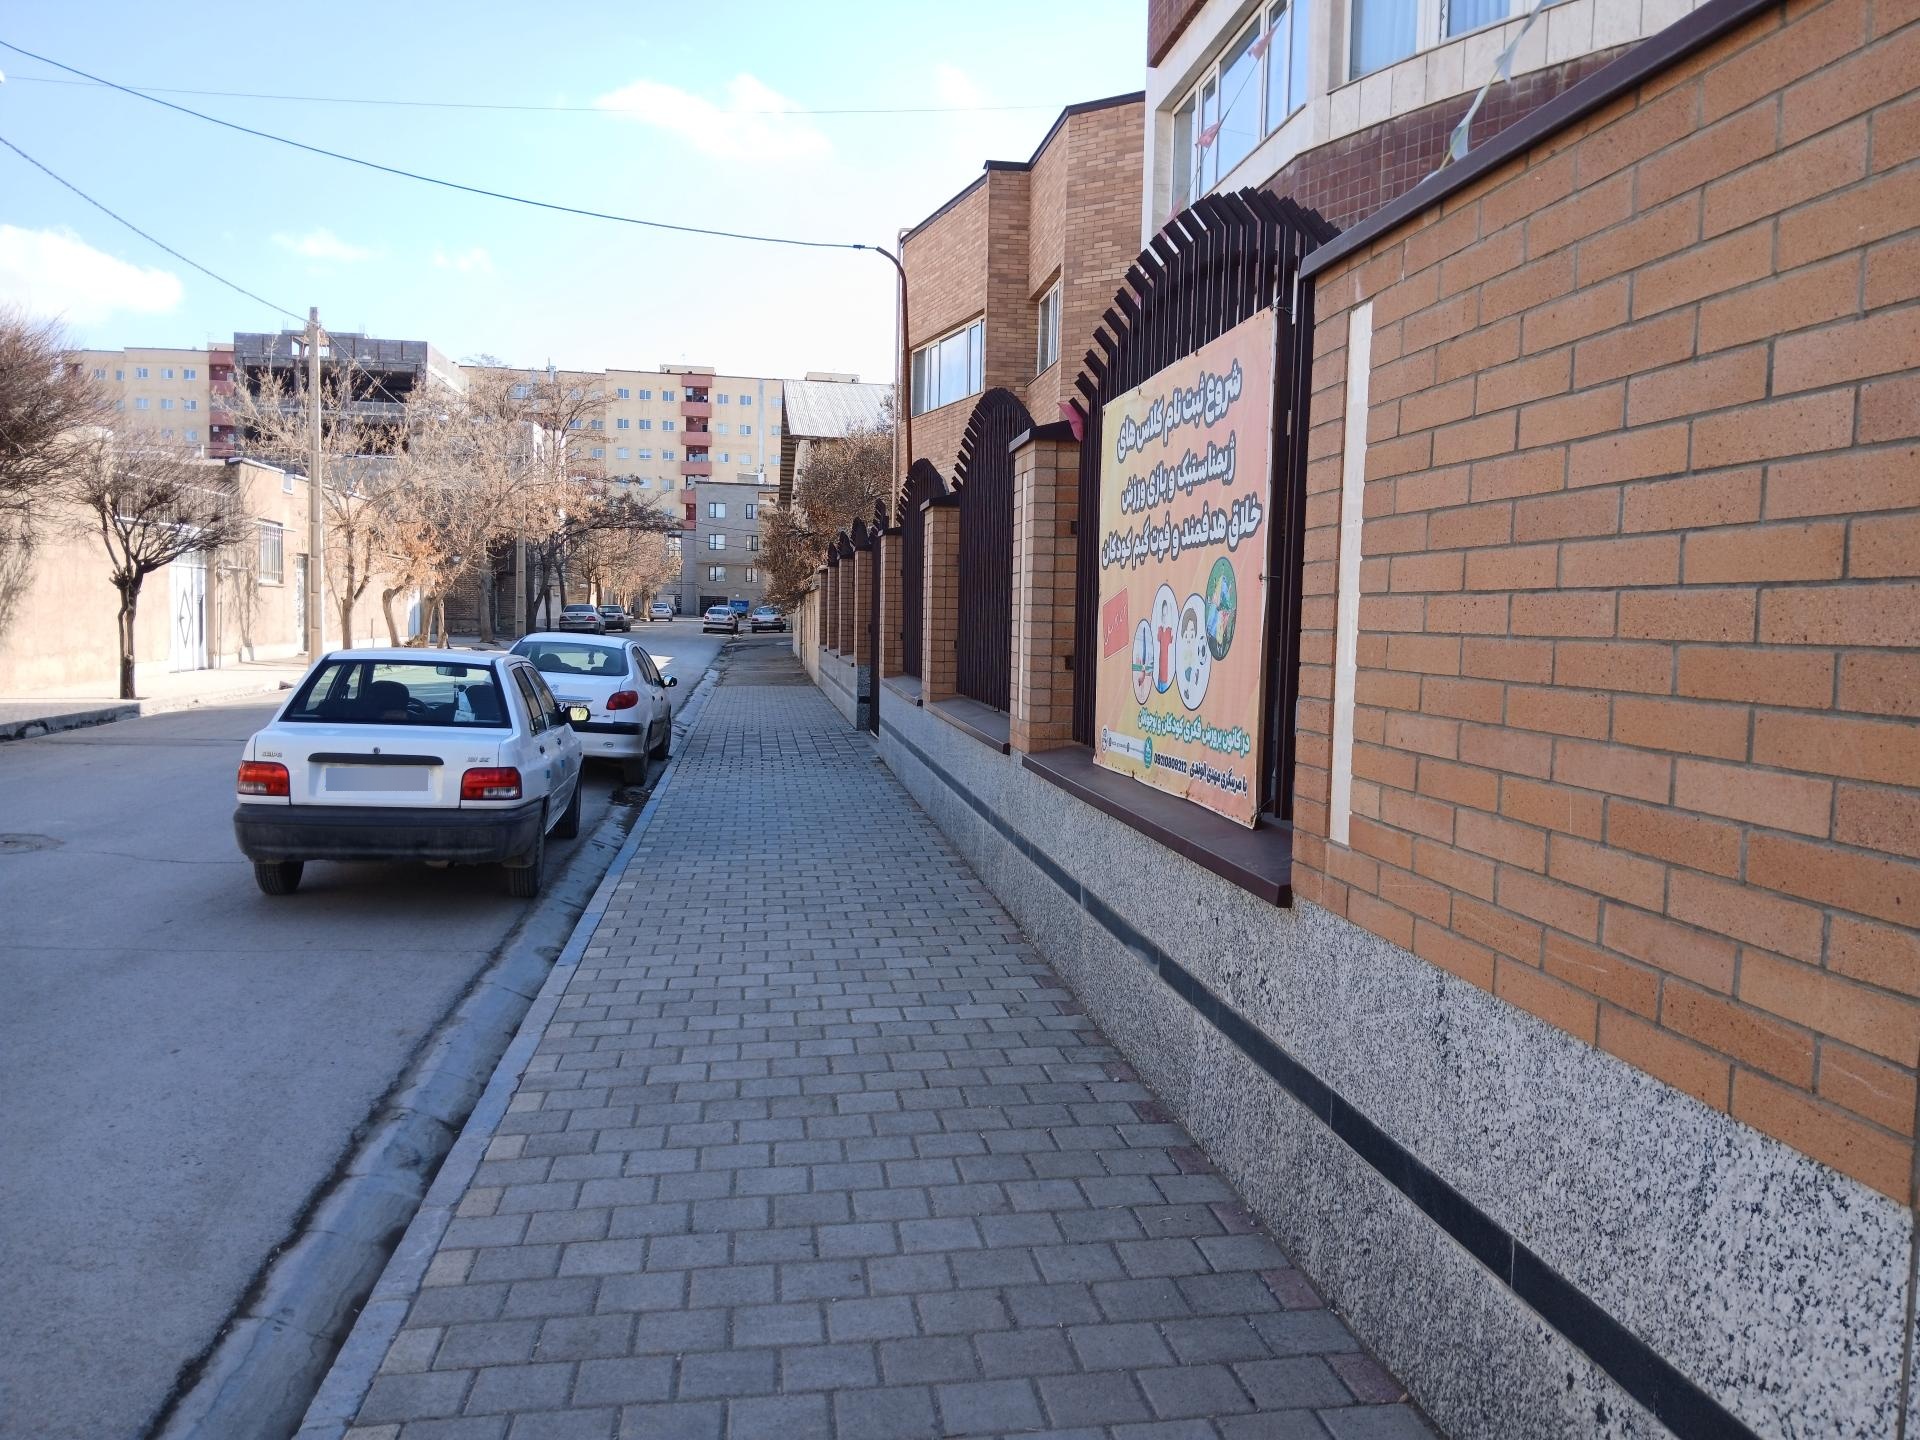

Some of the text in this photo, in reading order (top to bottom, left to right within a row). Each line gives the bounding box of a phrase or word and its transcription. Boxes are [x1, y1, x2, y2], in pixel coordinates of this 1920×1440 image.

[1182, 370, 1206, 429] ثبت
[1204, 358, 1242, 428] شروع
[1163, 387, 1182, 447] نام
[1121, 429, 1236, 515] ژیمناستیک و بازی ورزش
[1101, 491, 1263, 570] خلاق هدفمند و فوت گیم کودکان
[1161, 712, 1184, 740] کودکان
[1183, 714, 1202, 743] فکری
[1202, 722, 1223, 753] پرورش
[1222, 726, 1242, 754] کانون
[1240, 732, 1250, 758] در
[1242, 775, 1248, 797] با
